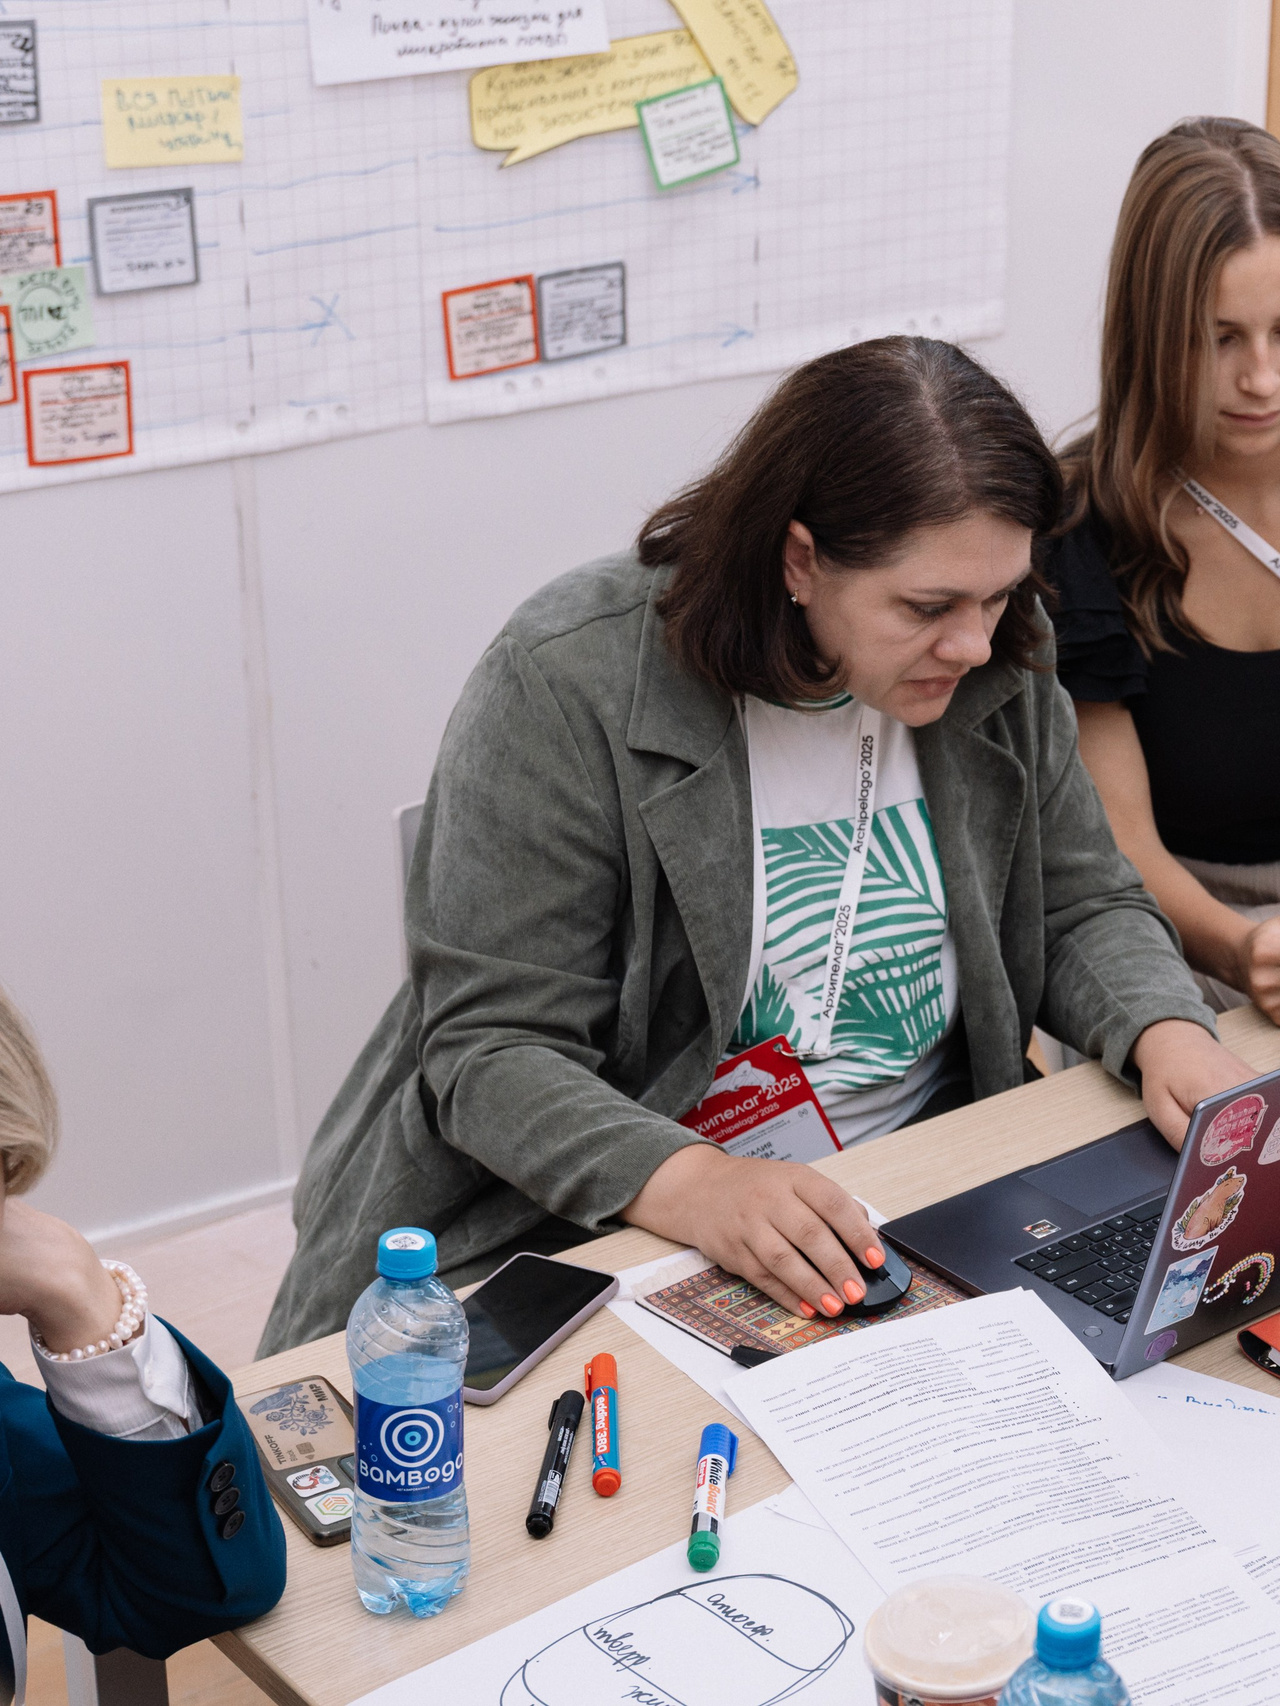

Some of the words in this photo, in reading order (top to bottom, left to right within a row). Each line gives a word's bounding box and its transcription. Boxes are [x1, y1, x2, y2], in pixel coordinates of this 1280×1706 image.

[371, 15, 424, 36] Почва
[853, 734, 874, 854] Archipelago'2025
[822, 903, 851, 1019] Архипелаг'2025
[691, 1073, 801, 1135] хипелаг'2025
[309, 1383, 328, 1402] МИР
[1049, 1425, 1074, 1433] стороны
[1075, 1417, 1101, 1427] Сильные
[264, 1434, 287, 1465] TINKOFF
[596, 1431, 608, 1454] 380
[1059, 1441, 1100, 1454] Самообучение
[1056, 1456, 1112, 1472] Масштабируемость
[706, 1457, 723, 1516] WhiteBoard
[1111, 1506, 1143, 1517] принципы
[1144, 1497, 1174, 1508] Ключевые
